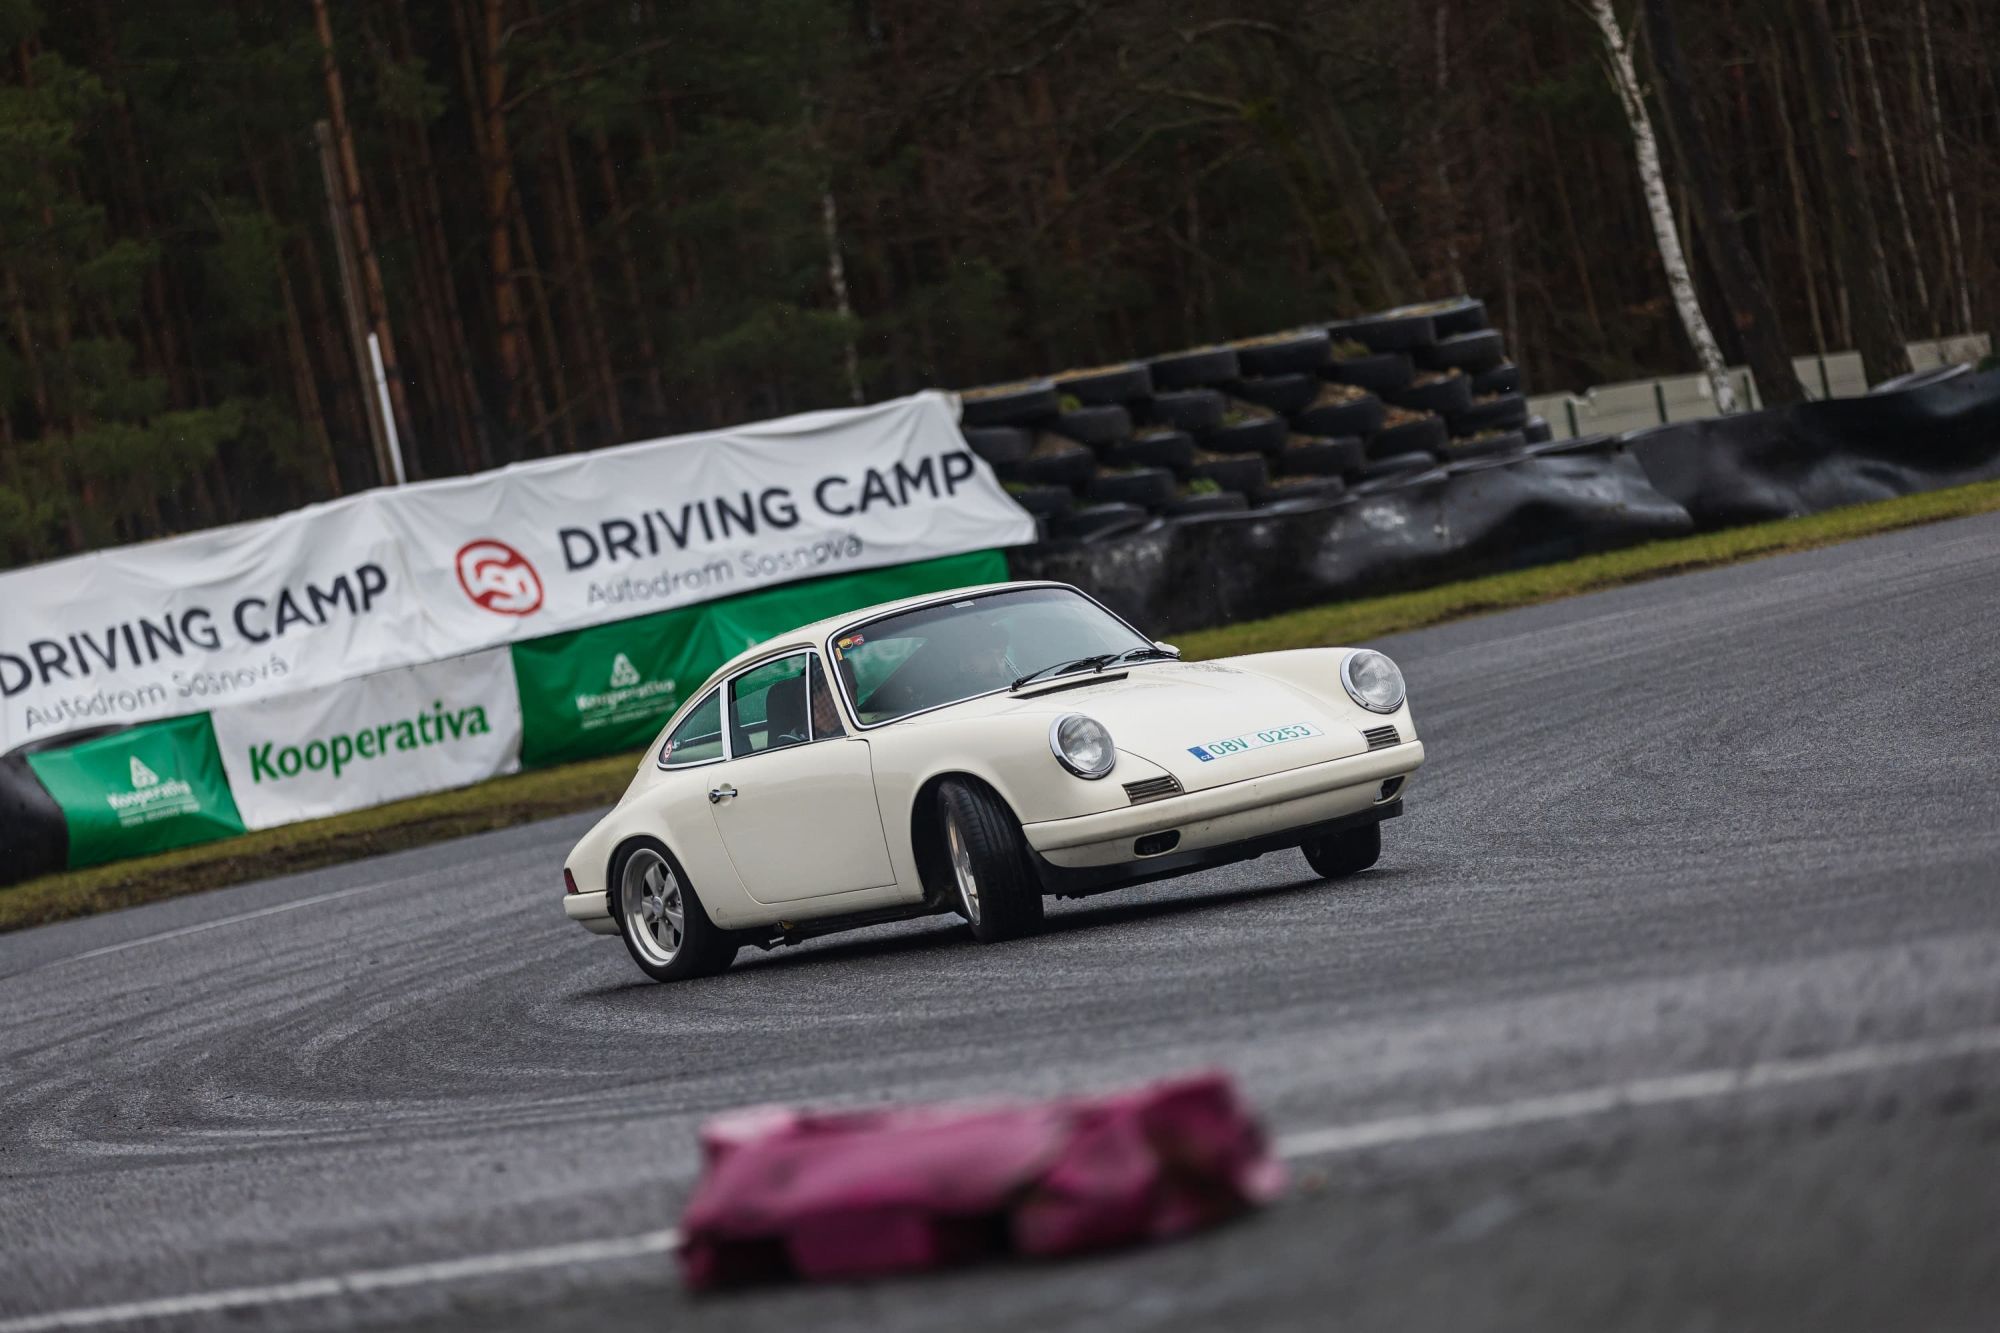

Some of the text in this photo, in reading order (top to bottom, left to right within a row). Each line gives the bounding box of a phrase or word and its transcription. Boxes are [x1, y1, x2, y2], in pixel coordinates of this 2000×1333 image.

[558, 450, 976, 572] DRIVING CAMP
[587, 558, 735, 606] Autodrom
[0, 562, 388, 697] DRIVING CAMP
[25, 681, 168, 732] Autodrom
[1207, 725, 1311, 756] 08V 0253
[248, 699, 491, 784] Kooperativa
